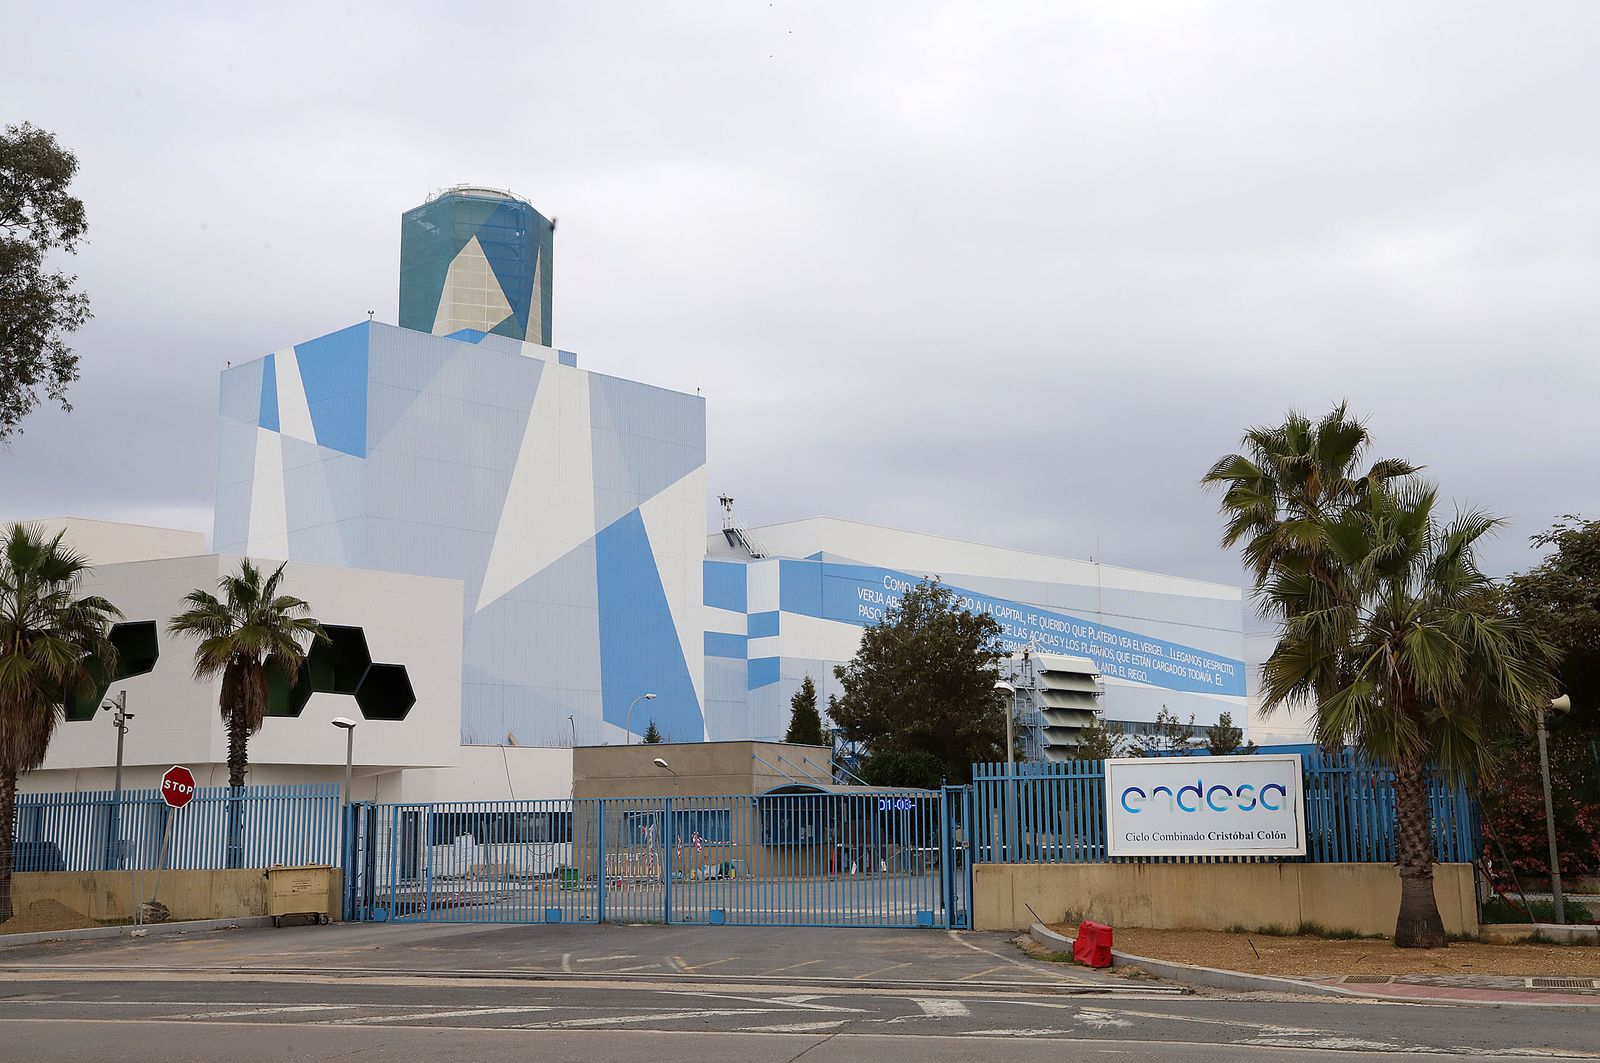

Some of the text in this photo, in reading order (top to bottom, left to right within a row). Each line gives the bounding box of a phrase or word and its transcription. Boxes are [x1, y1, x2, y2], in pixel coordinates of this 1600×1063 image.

[857, 586, 884, 605] VERJA
[1001, 622, 1012, 636] DE
[1013, 625, 1028, 639] LAS
[1029, 630, 1059, 647] ACACIAS
[1060, 636, 1065, 647] Y
[1065, 637, 1080, 651] LOS
[1081, 641, 1115, 662] PLÁTANOS,
[1116, 650, 1130, 664] QUE
[1131, 654, 1151, 669] ESTÁN
[1152, 659, 1187, 677] CARGADOS
[1215, 673, 1224, 687] EL
[858, 604, 882, 621] PASO
[1118, 666, 1127, 677] EL
[883, 575, 911, 593] COMO
[976, 602, 982, 612] A
[983, 602, 994, 615] LA
[995, 605, 1026, 625] CAPITAL,
[1027, 613, 1038, 625] HE
[1039, 616, 1071, 634] QUERIDO
[1071, 624, 1087, 638] QUE
[1088, 626, 1118, 645] PLATERO
[1118, 635, 1132, 649] VEA
[1132, 639, 1140, 650] EL
[1203, 658, 1235, 677] DESPACITO,
[164, 780, 193, 794] STOP
[1121, 778, 1287, 814] endesa
[1125, 830, 1287, 842] Ciclo Combinado Cristóbal Colón
